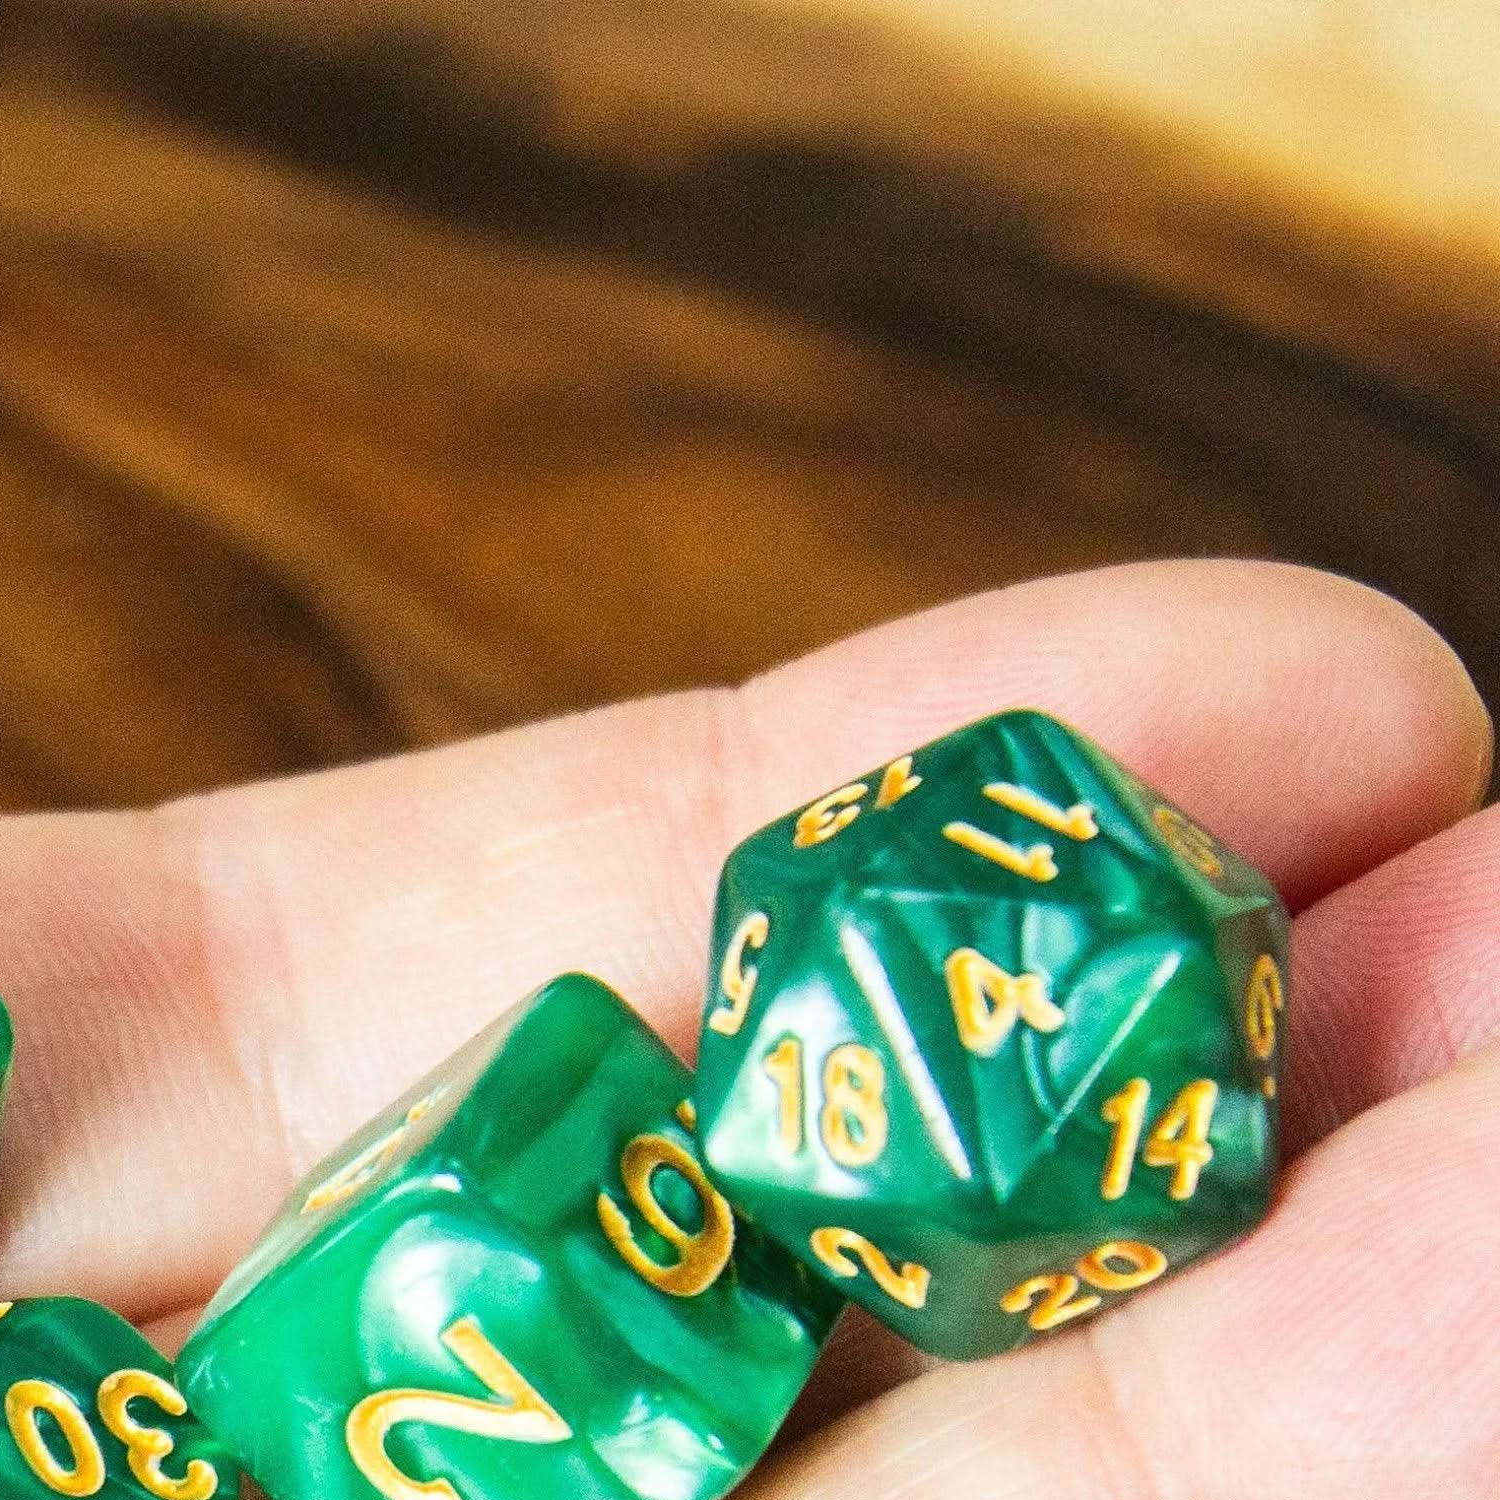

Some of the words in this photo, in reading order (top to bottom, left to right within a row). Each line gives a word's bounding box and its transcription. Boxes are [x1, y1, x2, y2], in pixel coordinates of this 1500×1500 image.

[942, 781, 1100, 883] 11
[944, 947, 1066, 1058] 4
[764, 1037, 889, 1167] 18
[1102, 1077, 1219, 1201] 14
[810, 1226, 931, 1309] 2
[1000, 1239, 1168, 1331] 20
